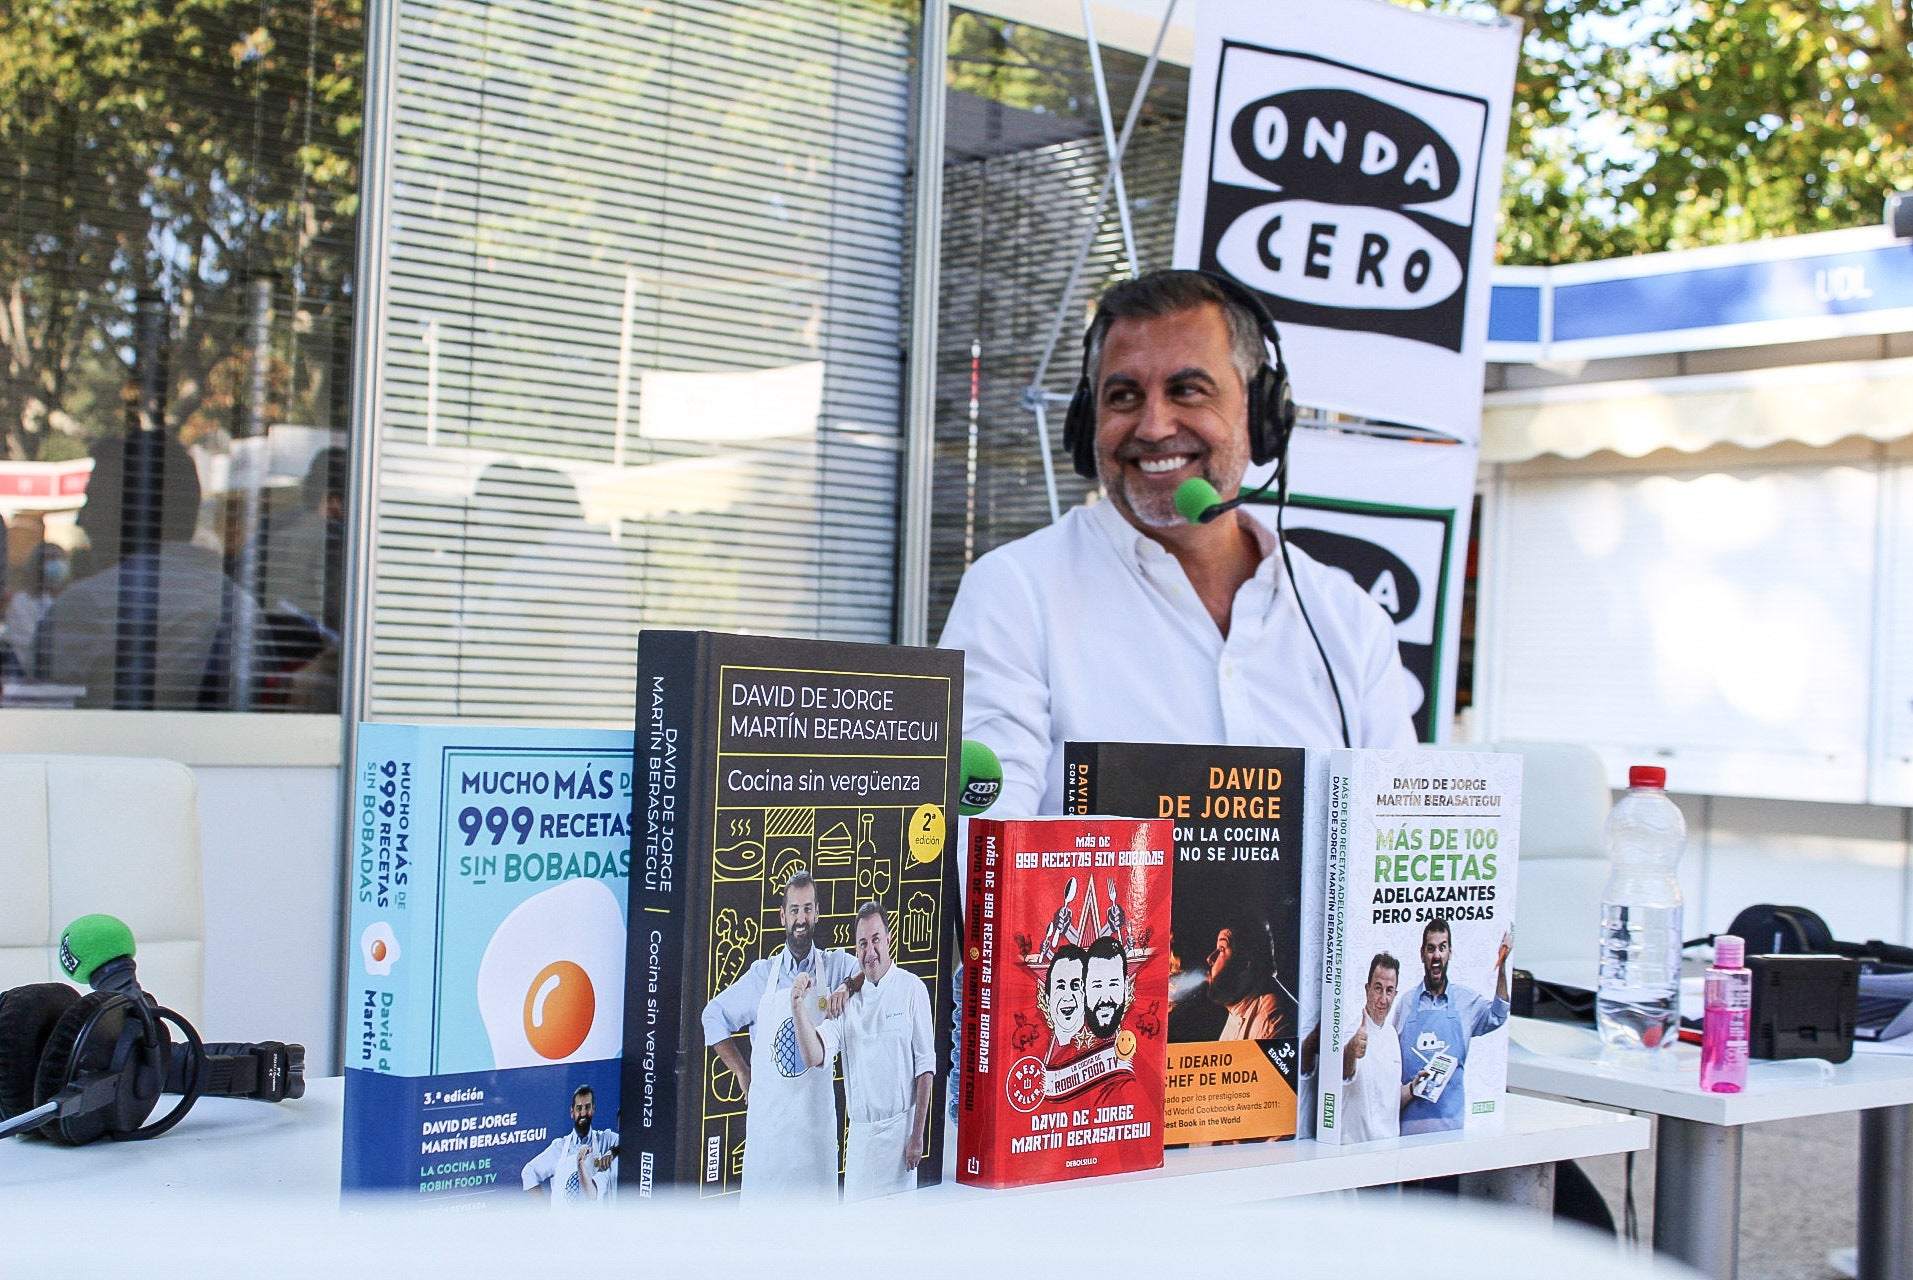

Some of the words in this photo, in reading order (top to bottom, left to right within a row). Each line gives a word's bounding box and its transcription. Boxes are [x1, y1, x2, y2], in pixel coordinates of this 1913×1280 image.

[1252, 105, 1441, 191] ONDA
[1256, 214, 1432, 294] CERO
[731, 683, 796, 708] DAVID
[801, 687, 828, 708] DE
[831, 687, 894, 711] JORGE
[650, 676, 664, 750] MARTÍN
[730, 711, 808, 738] MARTÍN
[814, 717, 939, 742] BERASATEGUI
[664, 728, 677, 790] DAVID
[365, 762, 377, 789] SIN
[379, 760, 397, 818] 999
[461, 771, 549, 795] MUCHO
[553, 762, 614, 800] MÁS
[620, 773, 633, 791] D
[727, 768, 793, 792] Cocina
[799, 770, 825, 792] sin
[829, 770, 921, 796] vergüenza
[1077, 764, 1089, 815] DAVID
[1209, 767, 1282, 790] DAVID
[1341, 777, 1349, 799] MÁS
[1393, 778, 1430, 790] DAVID
[1432, 779, 1448, 790] DE
[1450, 779, 1487, 790] JORGE
[399, 762, 411, 830] MUCHO
[1069, 789, 1076, 802] LA
[1331, 776, 1340, 808] DAVID
[1376, 791, 1421, 806] MARTÍN
[1424, 795, 1501, 807] BERASATEGUI
[662, 795, 675, 822] DE
[1158, 795, 1191, 818] DE
[1200, 796, 1281, 819] JORGE
[1331, 810, 1339, 825] DE
[1340, 801, 1348, 816] DE
[458, 806, 534, 846] 999
[540, 813, 632, 838] RECETAS
[645, 757, 661, 890] BERASATEGUI
[1173, 827, 1194, 842] ON
[1201, 828, 1218, 842] LA
[1224, 828, 1280, 842] COCINA
[1376, 823, 1423, 851] MÁS
[1429, 829, 1458, 850] DE
[1465, 828, 1499, 850] 100
[359, 795, 376, 903] BOBADAS
[915, 834, 940, 846] edición
[985, 836, 999, 866] MÁS
[1075, 833, 1096, 848] MÁS
[1098, 836, 1111, 848] DE
[1180, 847, 1200, 861] NO
[1207, 847, 1226, 861] SE
[1231, 847, 1280, 861] JUEGA
[1330, 826, 1338, 861] JORGE
[377, 822, 392, 908] RECETAS
[395, 834, 412, 886] MÁS
[460, 855, 497, 878] SIN
[504, 850, 631, 883] BOBADAS
[659, 827, 674, 893] JORGE
[1015, 853, 1039, 869] 999
[1041, 851, 1092, 868] RECETAS
[1094, 851, 1115, 866] SIN
[1118, 850, 1165, 866] BOBADAS
[1338, 837, 1347, 883] RECETAS
[1374, 853, 1498, 883] RECETAS
[985, 870, 995, 888] DE
[1328, 872, 1337, 912] MARTÍN
[398, 892, 406, 910] DE
[984, 893, 994, 918] 999
[1372, 886, 1496, 904] ADELGAZANTES
[1335, 884, 1345, 965] ADELGAZANTES
[1372, 907, 1412, 924] PERO
[1415, 905, 1494, 922] SABROSAS
[648, 930, 662, 994] Cocina
[981, 922, 993, 984] RECETAS
[1325, 915, 1334, 984] BERASATEGUI
[1334, 968, 1342, 996] PERO
[646, 998, 660, 1026] sin
[980, 988, 991, 1010] SIN
[362, 990, 377, 1060] Martín
[379, 992, 394, 1051] David
[1332, 998, 1341, 1053] SABROSAS
[979, 1014, 991, 1074] BOBADAS
[379, 1058, 390, 1072] d
[1015, 1064, 1041, 1080] BEST
[1180, 1054, 1233, 1069] IDEARIO
[1268, 1047, 1290, 1075] EDICIÓN
[642, 1029, 660, 1128] vergüenza
[1054, 1072, 1080, 1094] ROBIN
[1081, 1061, 1106, 1083] FOOD
[1107, 1057, 1119, 1071] TV
[1165, 1074, 1194, 1088] HEF
[1199, 1073, 1216, 1086] DE
[1221, 1070, 1258, 1084] MODA
[443, 1088, 484, 1104] edición
[1013, 1087, 1041, 1105] SELLER
[1173, 1106, 1195, 1115] World
[1196, 1103, 1235, 1114] Cookbooks
[1236, 1101, 1262, 1111] Awards
[1181, 1095, 1194, 1104] por
[1195, 1092, 1207, 1101] los
[1208, 1091, 1251, 1102] prestigiosos
[422, 1117, 459, 1135] DAVID
[461, 1115, 477, 1131] DE
[478, 1112, 517, 1130] JORGE
[1031, 1112, 1068, 1131] DAVID
[1073, 1111, 1089, 1126] DE
[1094, 1104, 1134, 1124] JORGE
[1178, 1119, 1197, 1128] Book
[1199, 1118, 1206, 1126] in
[1207, 1117, 1220, 1125] the
[1220, 1116, 1241, 1124] World
[1324, 1093, 1335, 1128] DEBATE
[421, 1135, 468, 1155] MARTÍN
[470, 1127, 547, 1149] BERASATEGUI
[1011, 1130, 1063, 1154] MARTÍN
[1067, 1122, 1151, 1147] BERASATEGUI
[421, 1165, 434, 1176] LA
[437, 1161, 476, 1176] COCINA
[478, 1158, 491, 1170] DE
[708, 1138, 720, 1181] DEBATE
[1065, 1157, 1098, 1168] DEBOLSILLO
[420, 1178, 450, 1193] ROBIN
[452, 1175, 482, 1190] FOOD
[484, 1173, 497, 1185] TV
[641, 1154, 653, 1197] DEBATE
